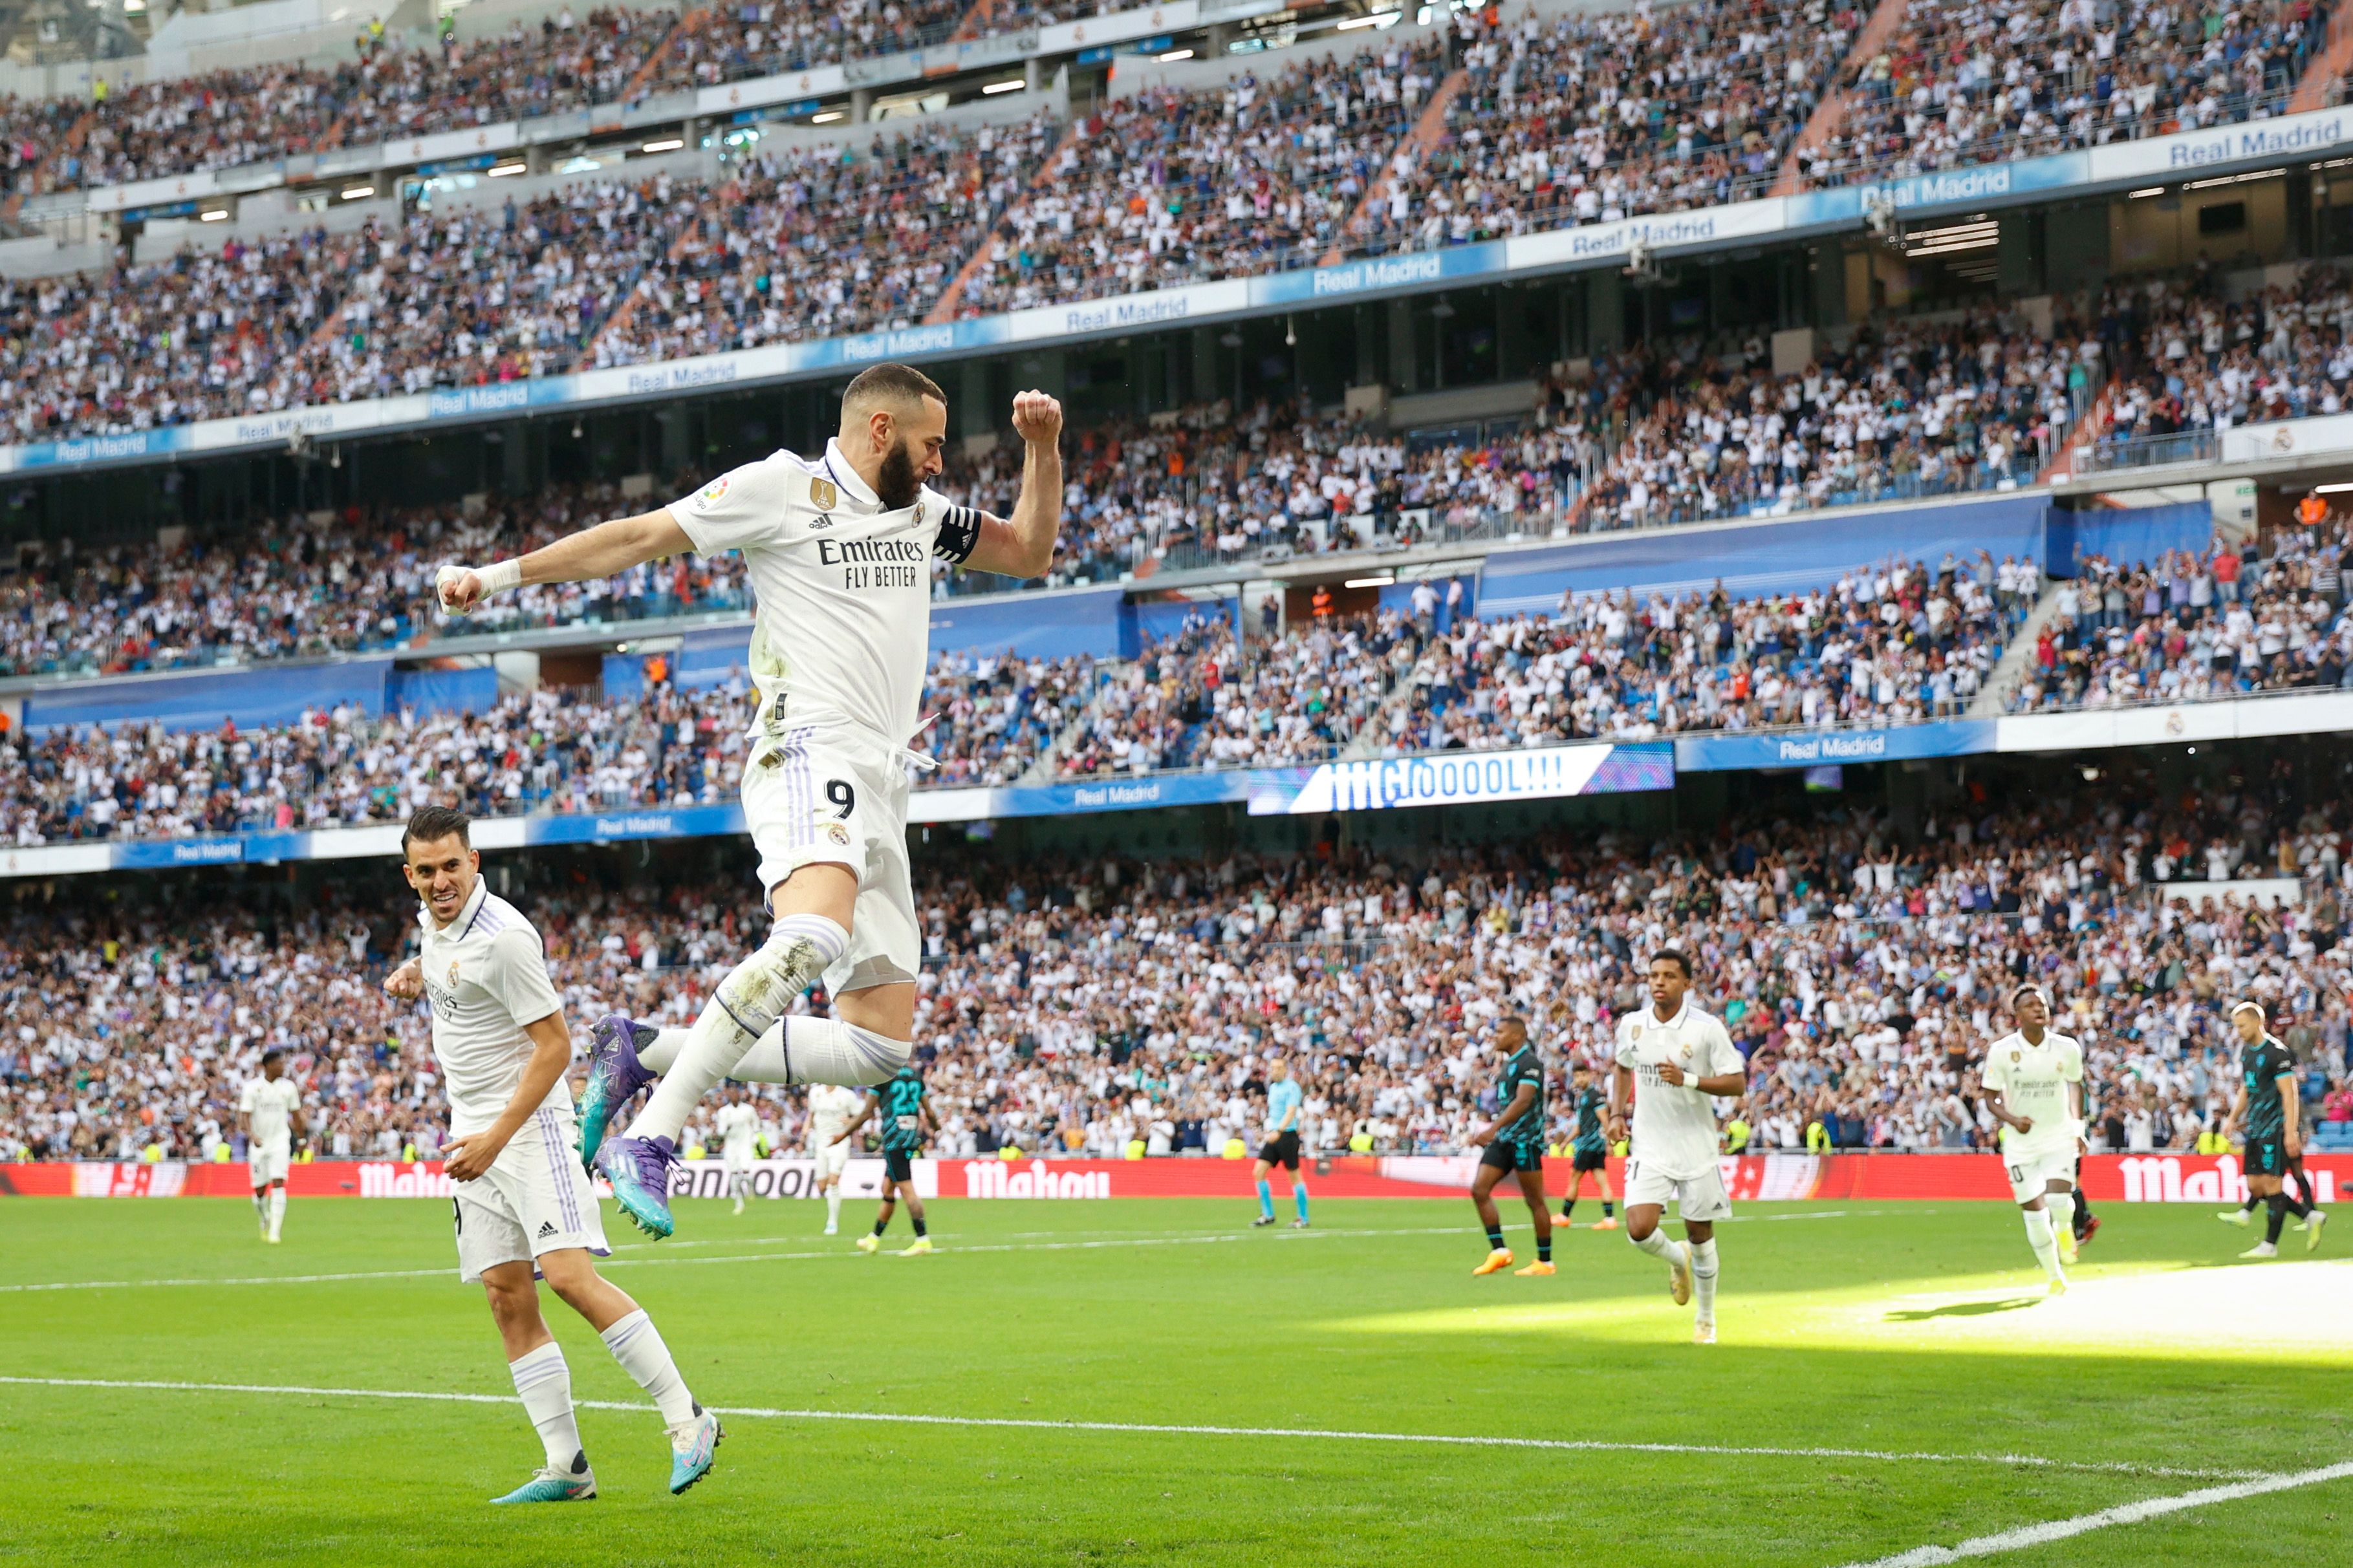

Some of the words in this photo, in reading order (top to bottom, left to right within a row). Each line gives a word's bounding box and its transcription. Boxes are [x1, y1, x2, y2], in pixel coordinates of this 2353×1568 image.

[2171, 135, 2232, 167] Real
[2239, 118, 2342, 160] Madrid
[1922, 167, 2010, 203] Madrid
[1573, 231, 1623, 254] Real
[1314, 266, 1358, 293] Real
[1365, 255, 1440, 286] Madrid
[1067, 307, 1111, 332] Real
[1118, 297, 1187, 323] Madrid
[843, 336, 884, 360] Real
[888, 326, 952, 352] Madrid
[629, 369, 668, 392] Real
[674, 361, 736, 385] Madrid
[431, 391, 464, 414] Real
[470, 384, 527, 408] Madrid
[56, 439, 91, 461] Real
[94, 435, 146, 455] Madrid
[817, 535, 924, 565] Emirates
[846, 567, 867, 589] FLY
[875, 566, 916, 587] BETTER
[1780, 739, 1819, 760] Real
[1822, 735, 1885, 757] Madrid
[824, 779, 854, 820] 9
[1074, 788, 1105, 806] Real
[1109, 784, 1159, 804] Madrid
[890, 1080, 922, 1115] 23
[358, 1161, 453, 1197] Maho
[964, 1159, 1110, 1199] Mahou
[538, 1230, 558, 1239] adidas
